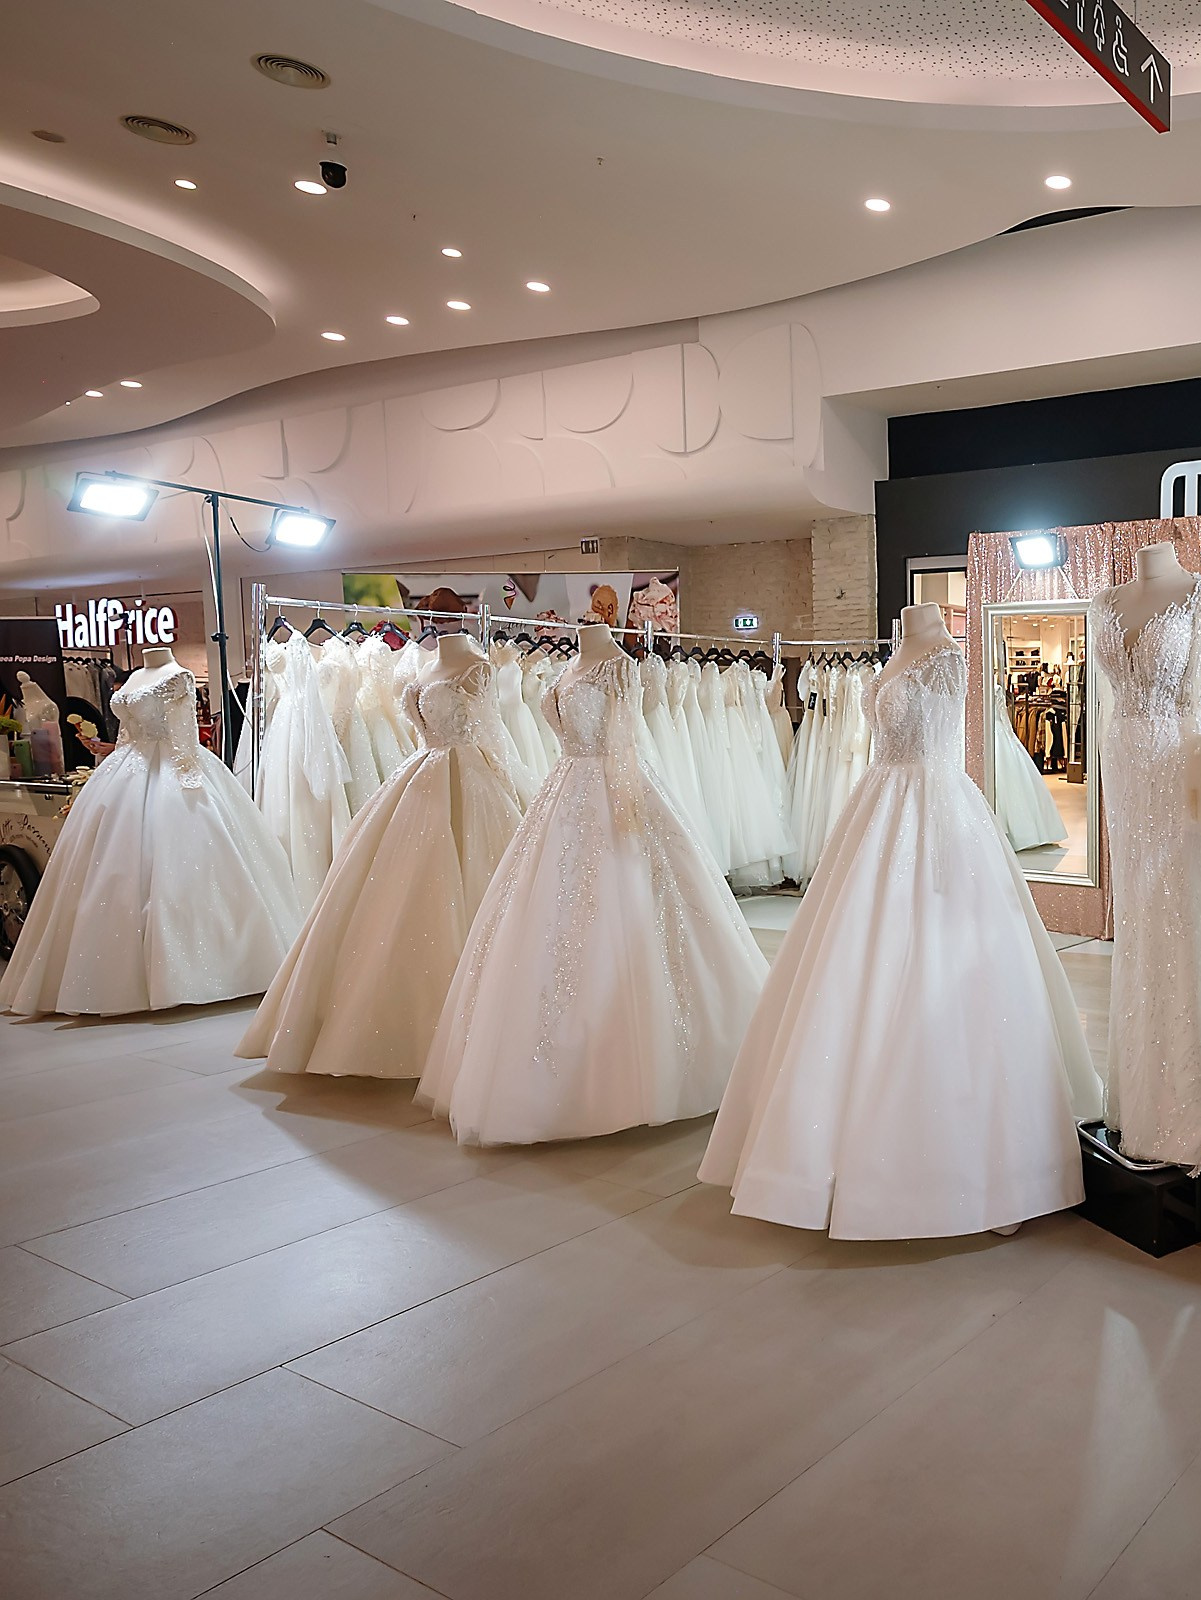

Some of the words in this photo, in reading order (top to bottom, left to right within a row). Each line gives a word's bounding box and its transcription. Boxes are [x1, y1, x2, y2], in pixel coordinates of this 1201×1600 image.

[55, 597, 176, 648] HalfPrice
[14, 655, 32, 664] Popa
[33, 655, 57, 664] Design
